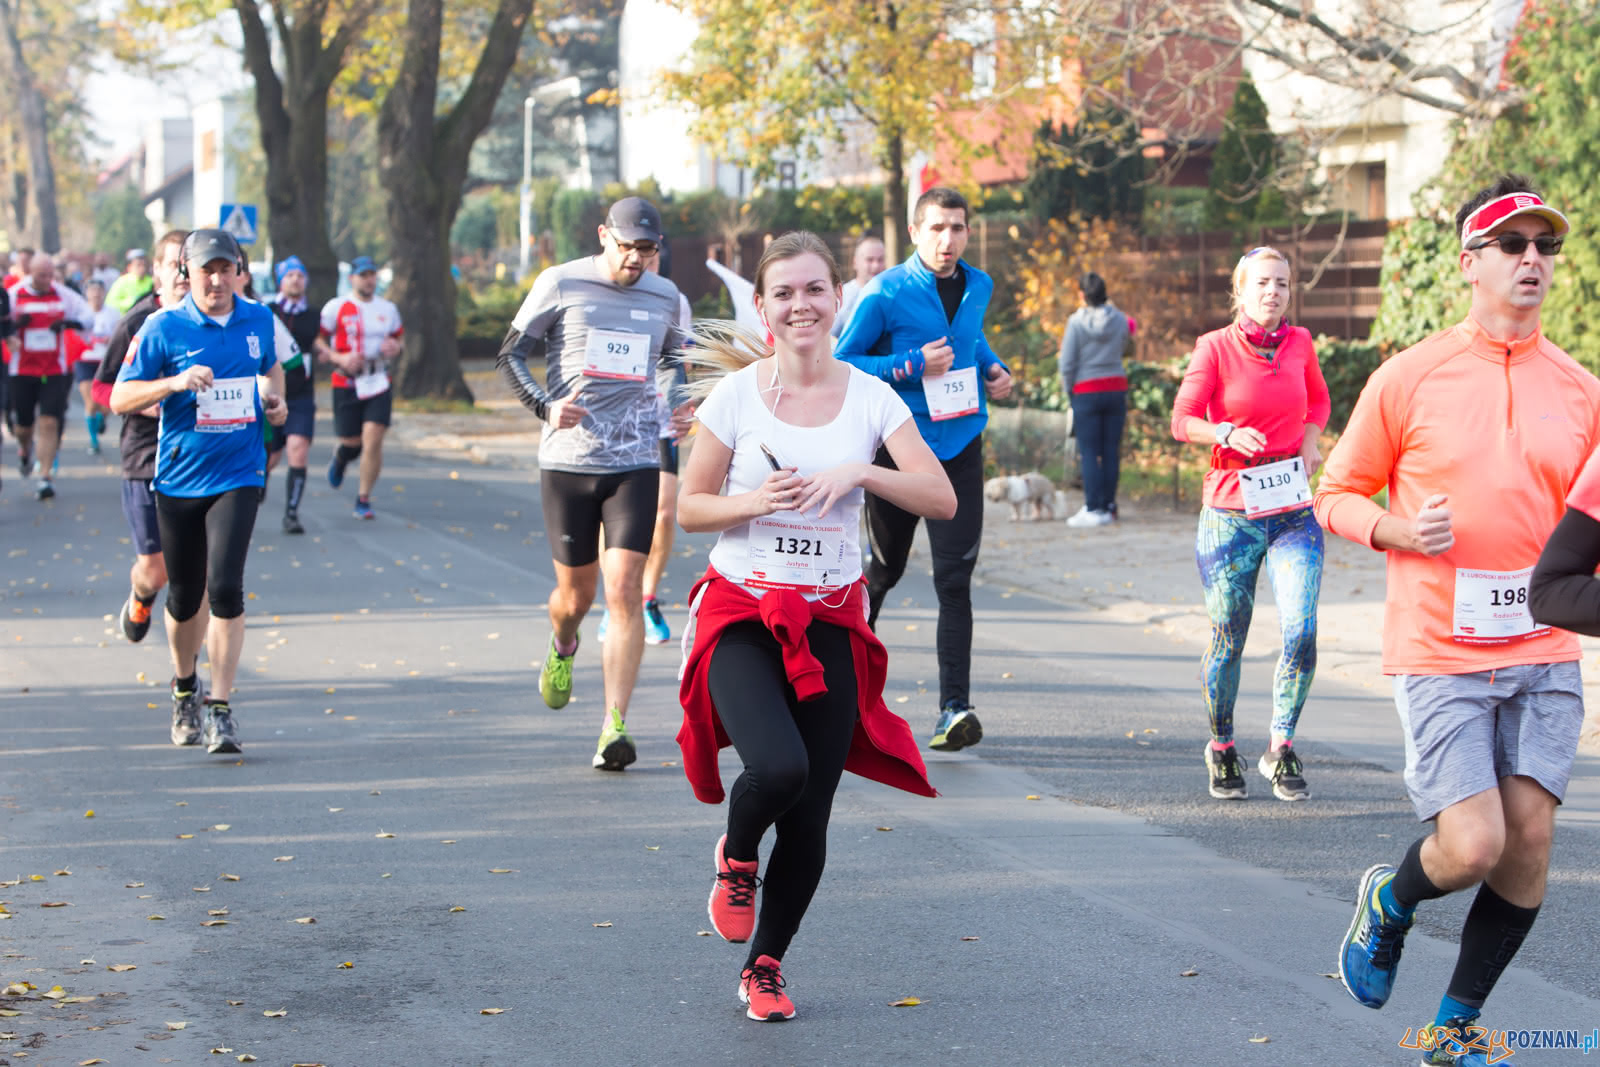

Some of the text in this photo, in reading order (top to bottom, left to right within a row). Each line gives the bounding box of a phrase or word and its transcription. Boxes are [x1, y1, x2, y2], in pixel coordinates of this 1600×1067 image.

[608, 342, 630, 355] 929
[214, 388, 242, 401] 1116
[943, 381, 965, 394] 755
[1258, 472, 1291, 490] 1130
[774, 537, 823, 556] 1321
[1490, 587, 1527, 606] 198
